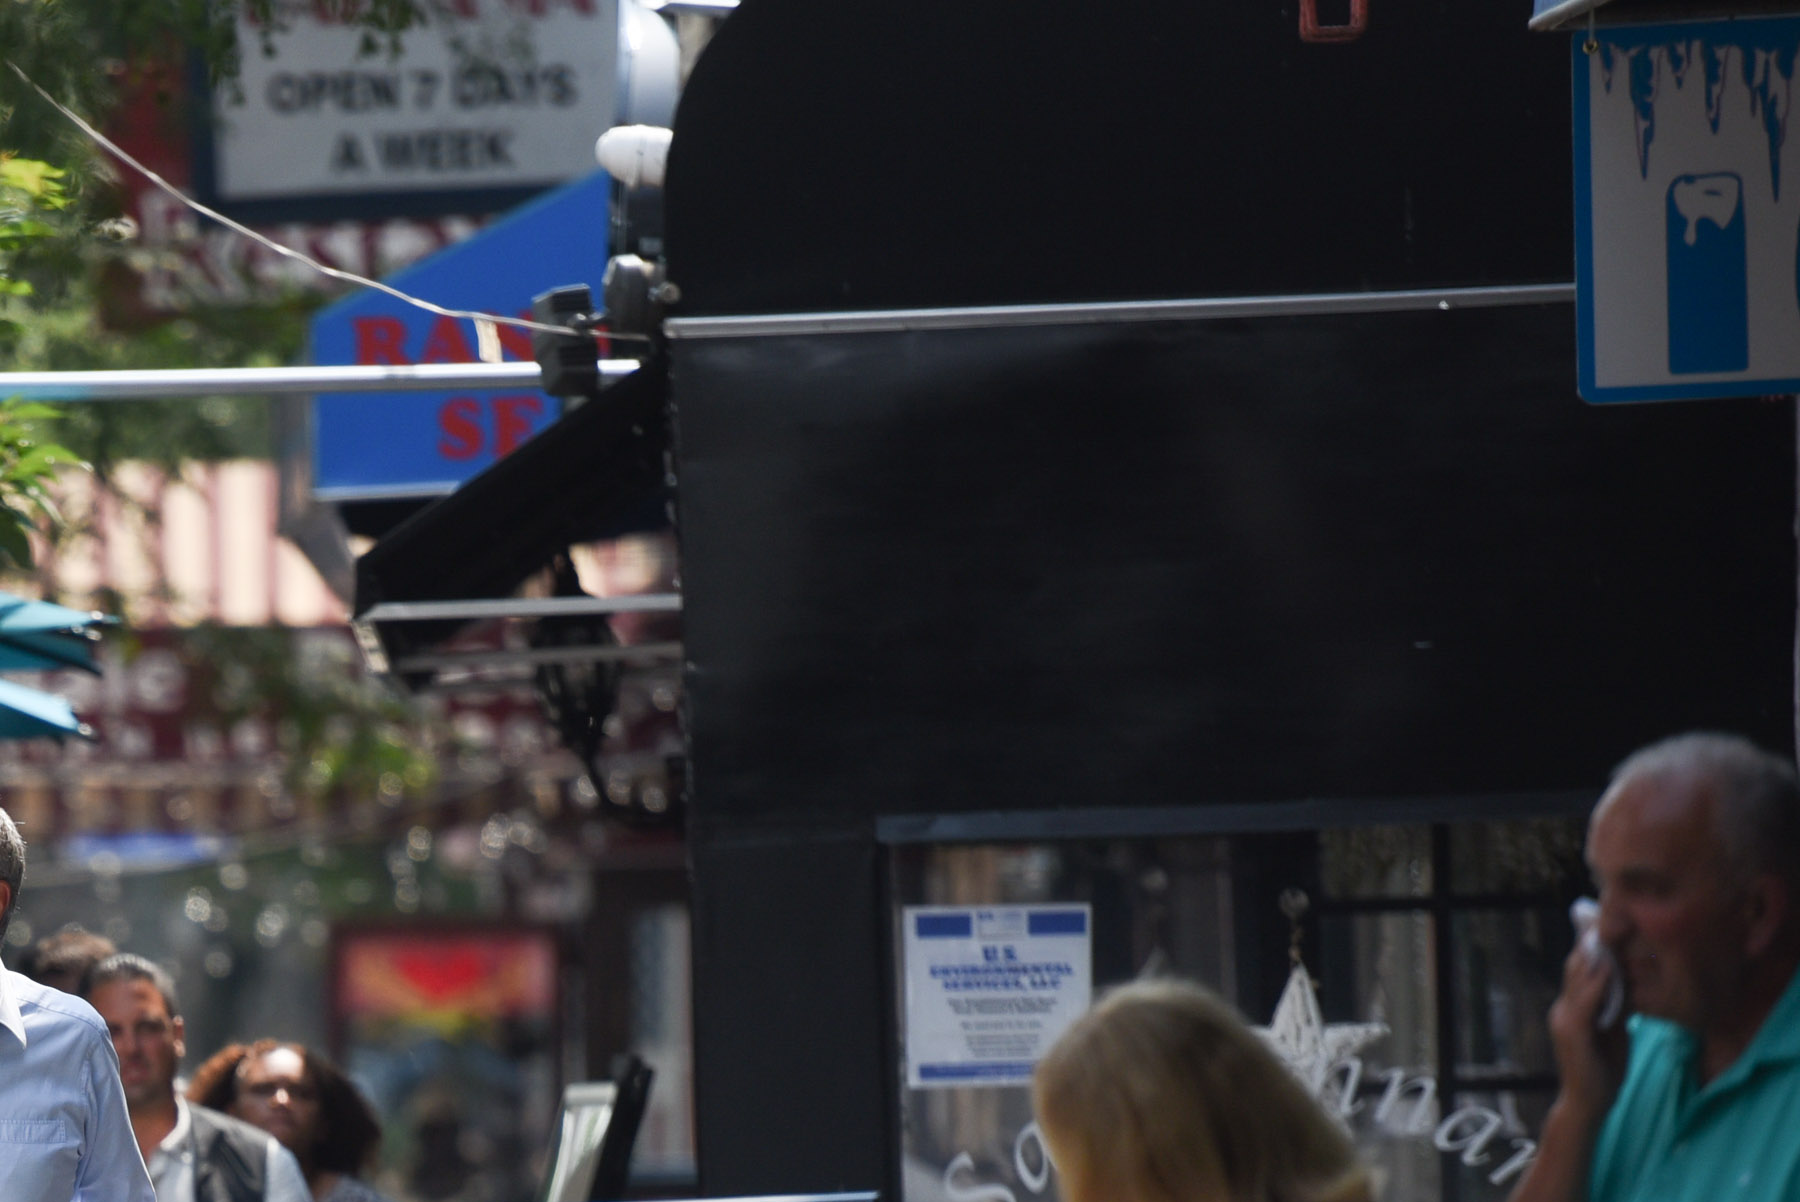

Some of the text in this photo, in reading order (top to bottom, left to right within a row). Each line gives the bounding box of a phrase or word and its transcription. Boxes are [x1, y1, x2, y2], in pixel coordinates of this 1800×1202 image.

[266, 63, 578, 112] OPEN 7 DAYS
[332, 127, 515, 170] A WEEK
